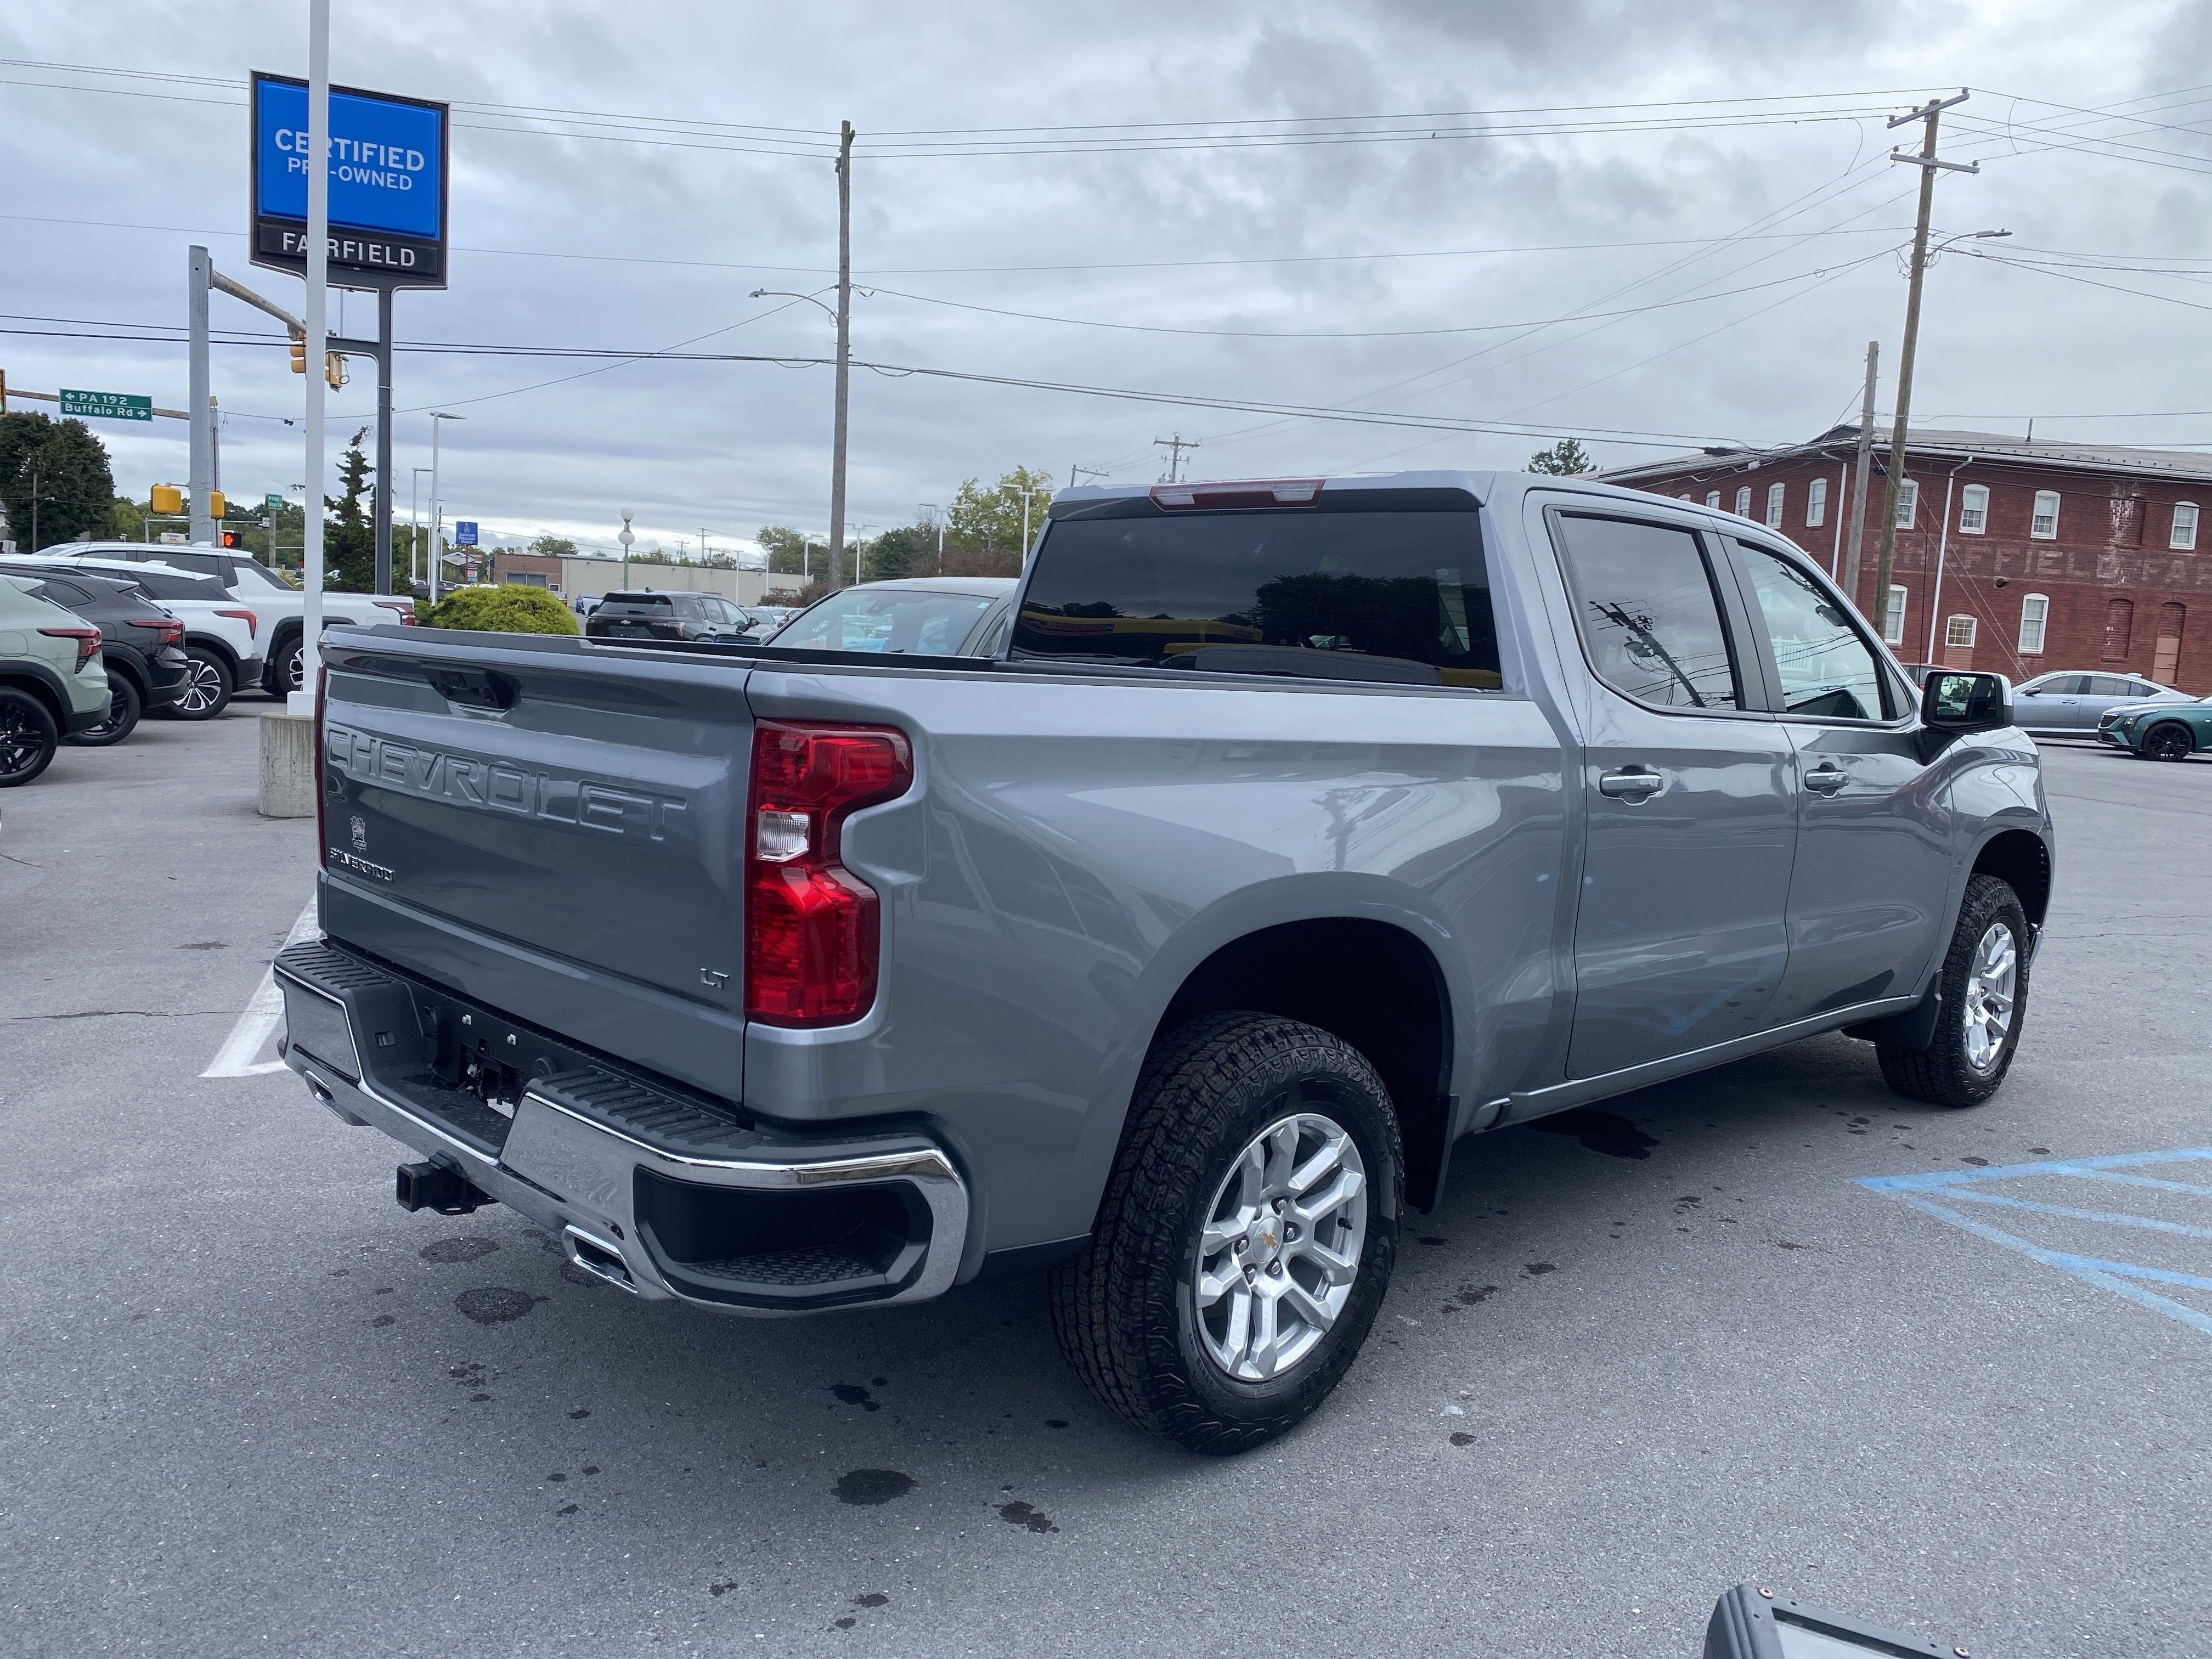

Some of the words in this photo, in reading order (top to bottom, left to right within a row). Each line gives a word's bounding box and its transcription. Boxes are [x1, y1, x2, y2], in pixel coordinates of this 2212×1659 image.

[275, 128, 425, 171] CETIFIED
[288, 157, 413, 190] P-OWNED
[283, 232, 416, 267] FARFIELD
[65, 403, 112, 415] Buffalo
[117, 408, 133, 417] Rd
[79, 393, 98, 403] PA
[103, 395, 127, 405] 192
[328, 729, 688, 841] CHEVROLET
[329, 847, 394, 881] SILVERADO
[701, 967, 730, 990] LT
[1295, 1235, 1391, 1403] GOODYEAR
